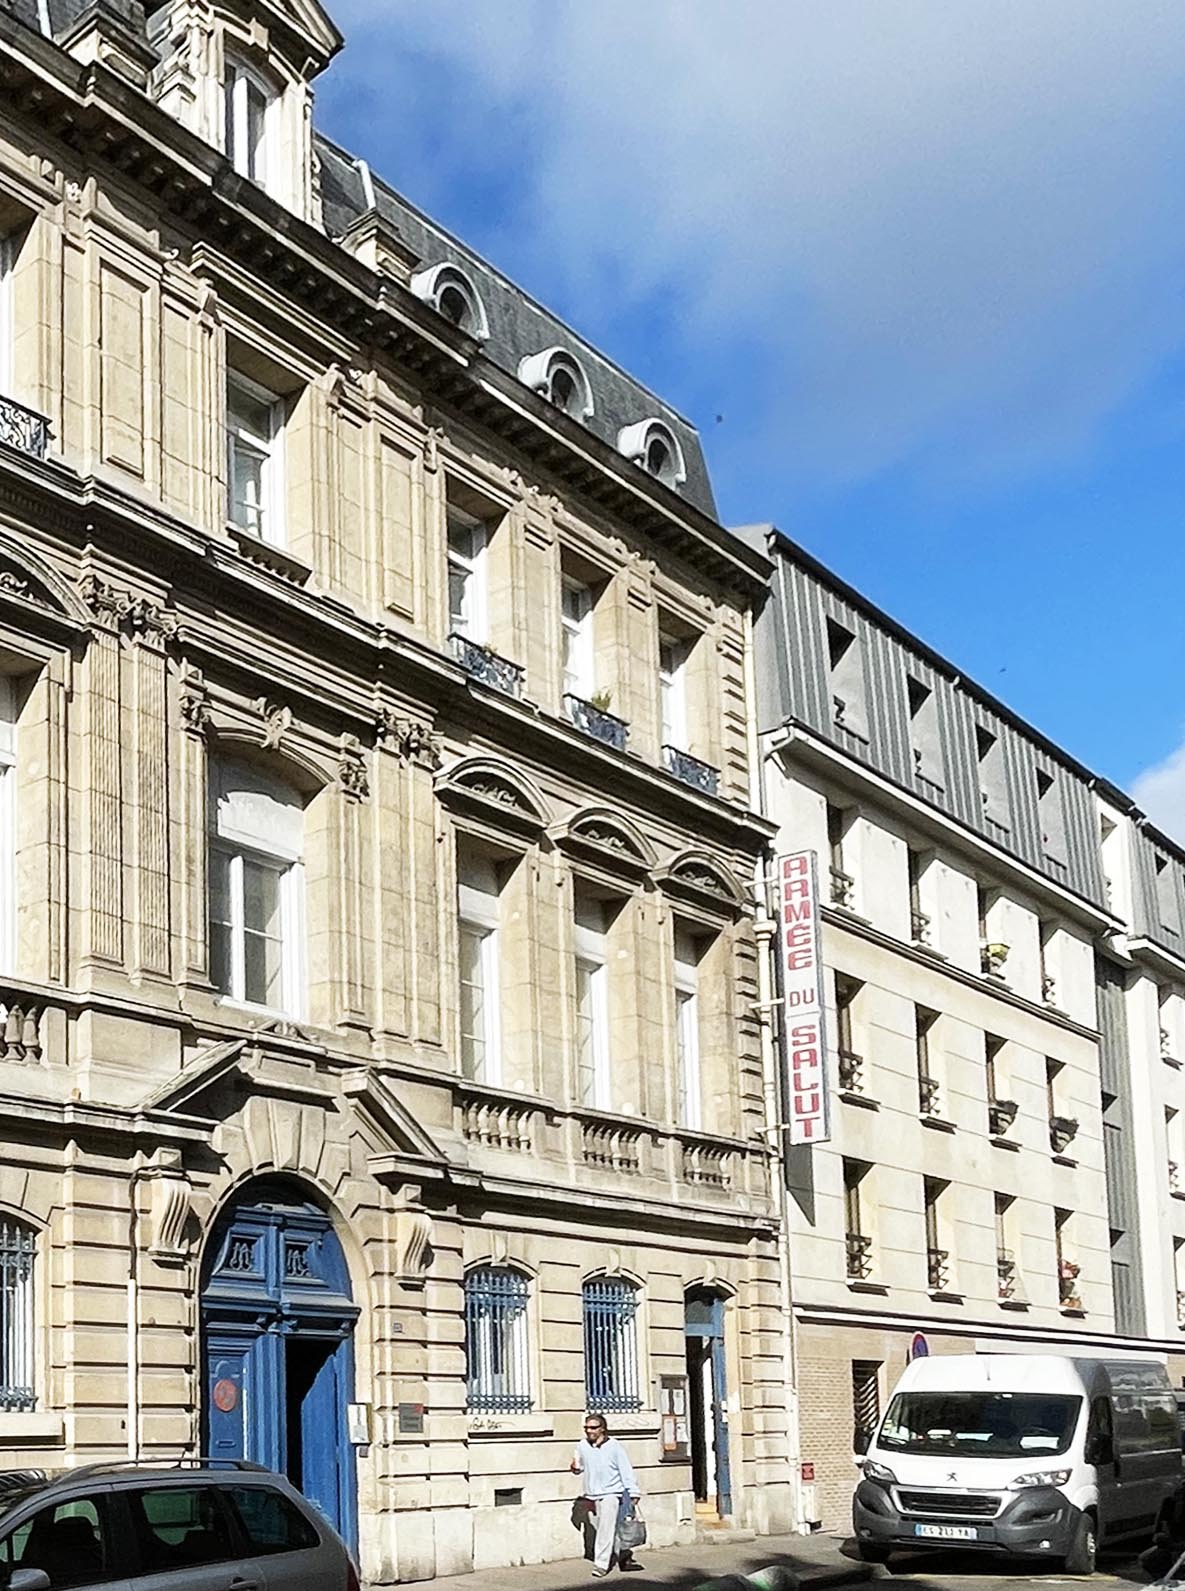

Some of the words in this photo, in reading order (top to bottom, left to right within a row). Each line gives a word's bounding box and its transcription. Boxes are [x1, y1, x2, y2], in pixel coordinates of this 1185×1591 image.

[783, 856, 812, 971] ARMÉE
[789, 987, 815, 1008] DU
[791, 1024, 820, 1138] SALUT
